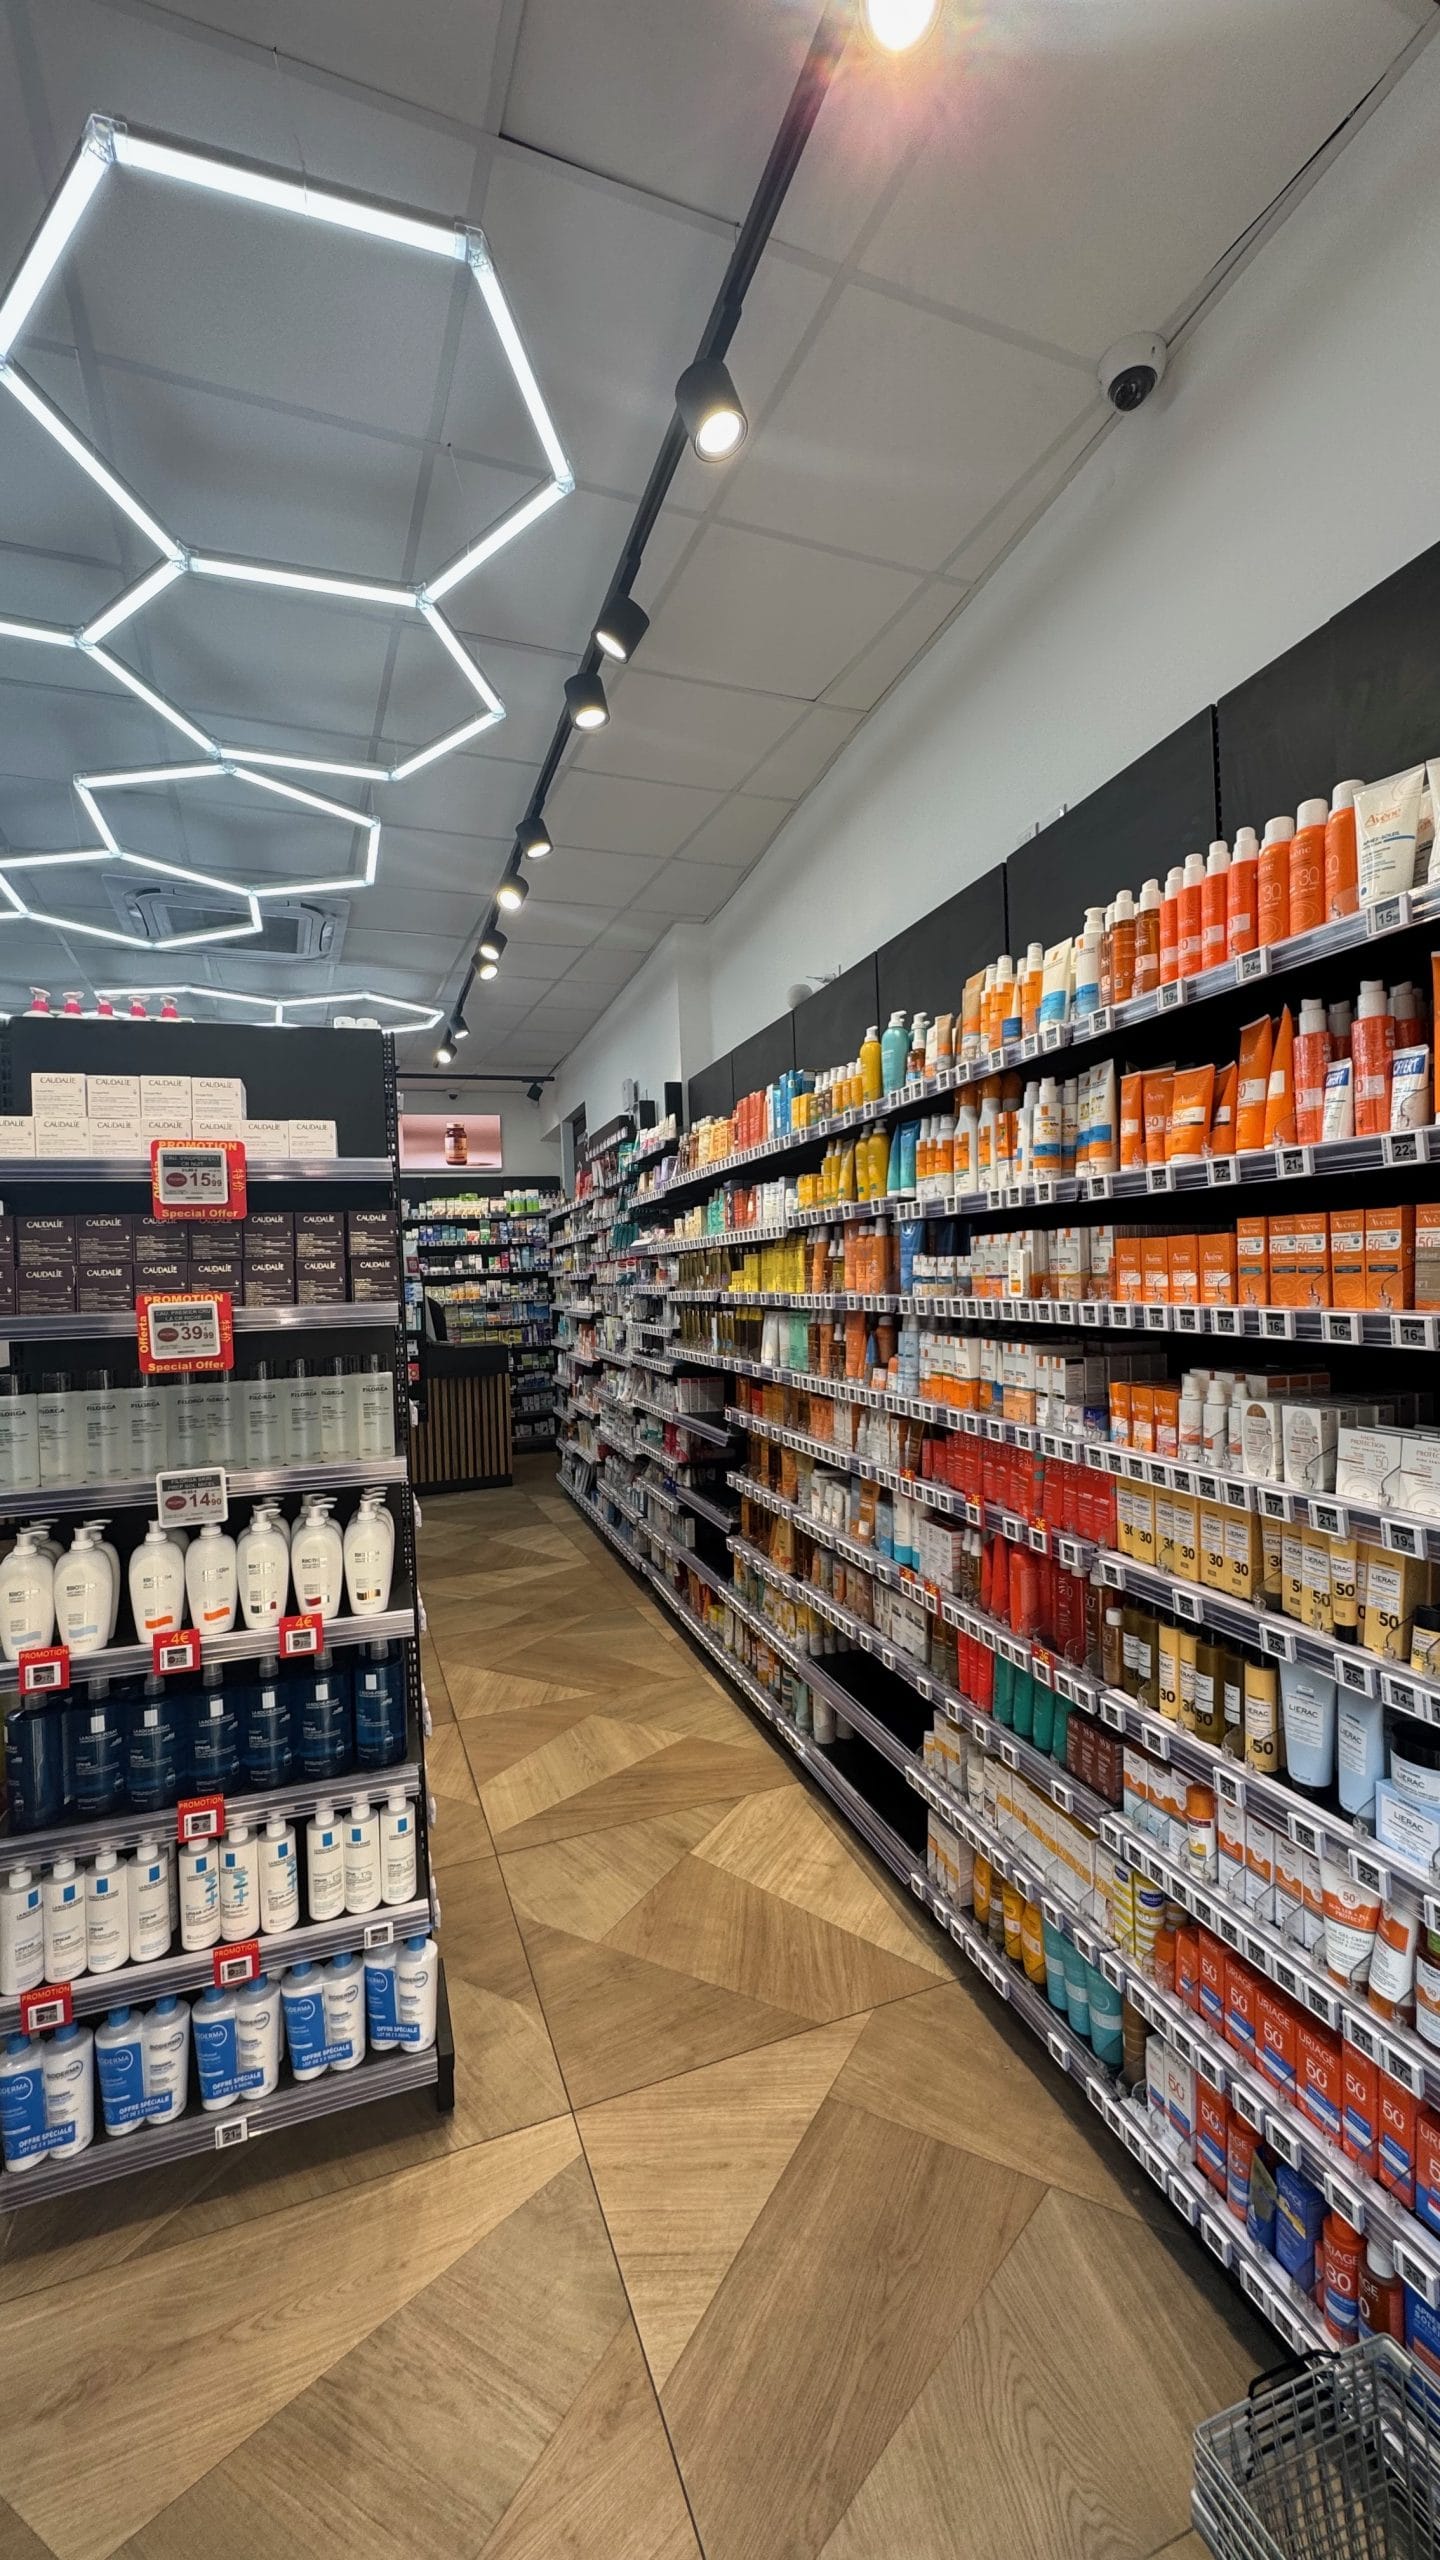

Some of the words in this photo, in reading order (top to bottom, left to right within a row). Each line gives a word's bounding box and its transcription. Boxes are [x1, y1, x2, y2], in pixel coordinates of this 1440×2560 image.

[1300, 866, 1320, 886] 30
[1394, 1144, 1410, 1157] 22
[190, 1172, 211, 1188] 15
[162, 1209, 206, 1219] Special
[210, 1208, 239, 1218] Offer
[1368, 1239, 1381, 1250] 50
[144, 1294, 224, 1304] PROMOTION
[181, 1326, 202, 1340] 39
[1269, 1320, 1280, 1332] 16
[1332, 1324, 1346, 1336] 16
[139, 1316, 149, 1354] Offerta
[1404, 1329, 1418, 1341] 16
[148, 1362, 192, 1372] Special
[196, 1360, 225, 1369] Offer
[190, 1493, 210, 1507] 14
[1140, 1531, 1152, 1544] 30
[1394, 1534, 1408, 1547] 19
[1182, 1548, 1195, 1560] 30
[1209, 1553, 1224, 1568] 30
[1234, 1562, 1249, 1576] 30
[1372, 1574, 1398, 1587] LIERAC
[1336, 1583, 1355, 1597] 50
[1379, 1611, 1399, 1629] 50
[20, 1649, 68, 1660] PROMOTION
[1346, 1670, 1359, 1684] 25
[1160, 1688, 1176, 1703] 30
[1288, 1704, 1319, 1719] LIERAC
[1253, 1738, 1273, 1754] 50
[1397, 1771, 1425, 1790] LIERAC
[178, 1797, 224, 1810] PROMOTION
[1394, 1811, 1424, 1833] LIERAC
[1343, 1890, 1356, 1903] 50
[215, 1943, 258, 1957] PROMOTION
[22, 1986, 70, 2001] PROMOTION
[1230, 1987, 1248, 2013] 50
[1257, 1994, 1290, 2029] URIAGE
[1264, 2021, 1283, 2050] 50
[302, 2052, 324, 2062] OFFRE
[324, 2044, 350, 2057] SPÉCIALE
[1298, 2028, 1336, 2066] URIAGE
[212, 2080, 233, 2090] OFFRE
[234, 2072, 262, 2086] SPÉCIALE
[1306, 2058, 1328, 2089] 50
[1168, 2072, 1185, 2101] 50
[1345, 2073, 1366, 2101] 50
[119, 2104, 139, 2115] OFFRE
[140, 2096, 170, 2110] SPÉCIALE
[1382, 2100, 1405, 2130] 50
[19, 2134, 41, 2148] OFFRE
[42, 2126, 73, 2142] SPÉCIALE
[1326, 2262, 1351, 2292] 30
